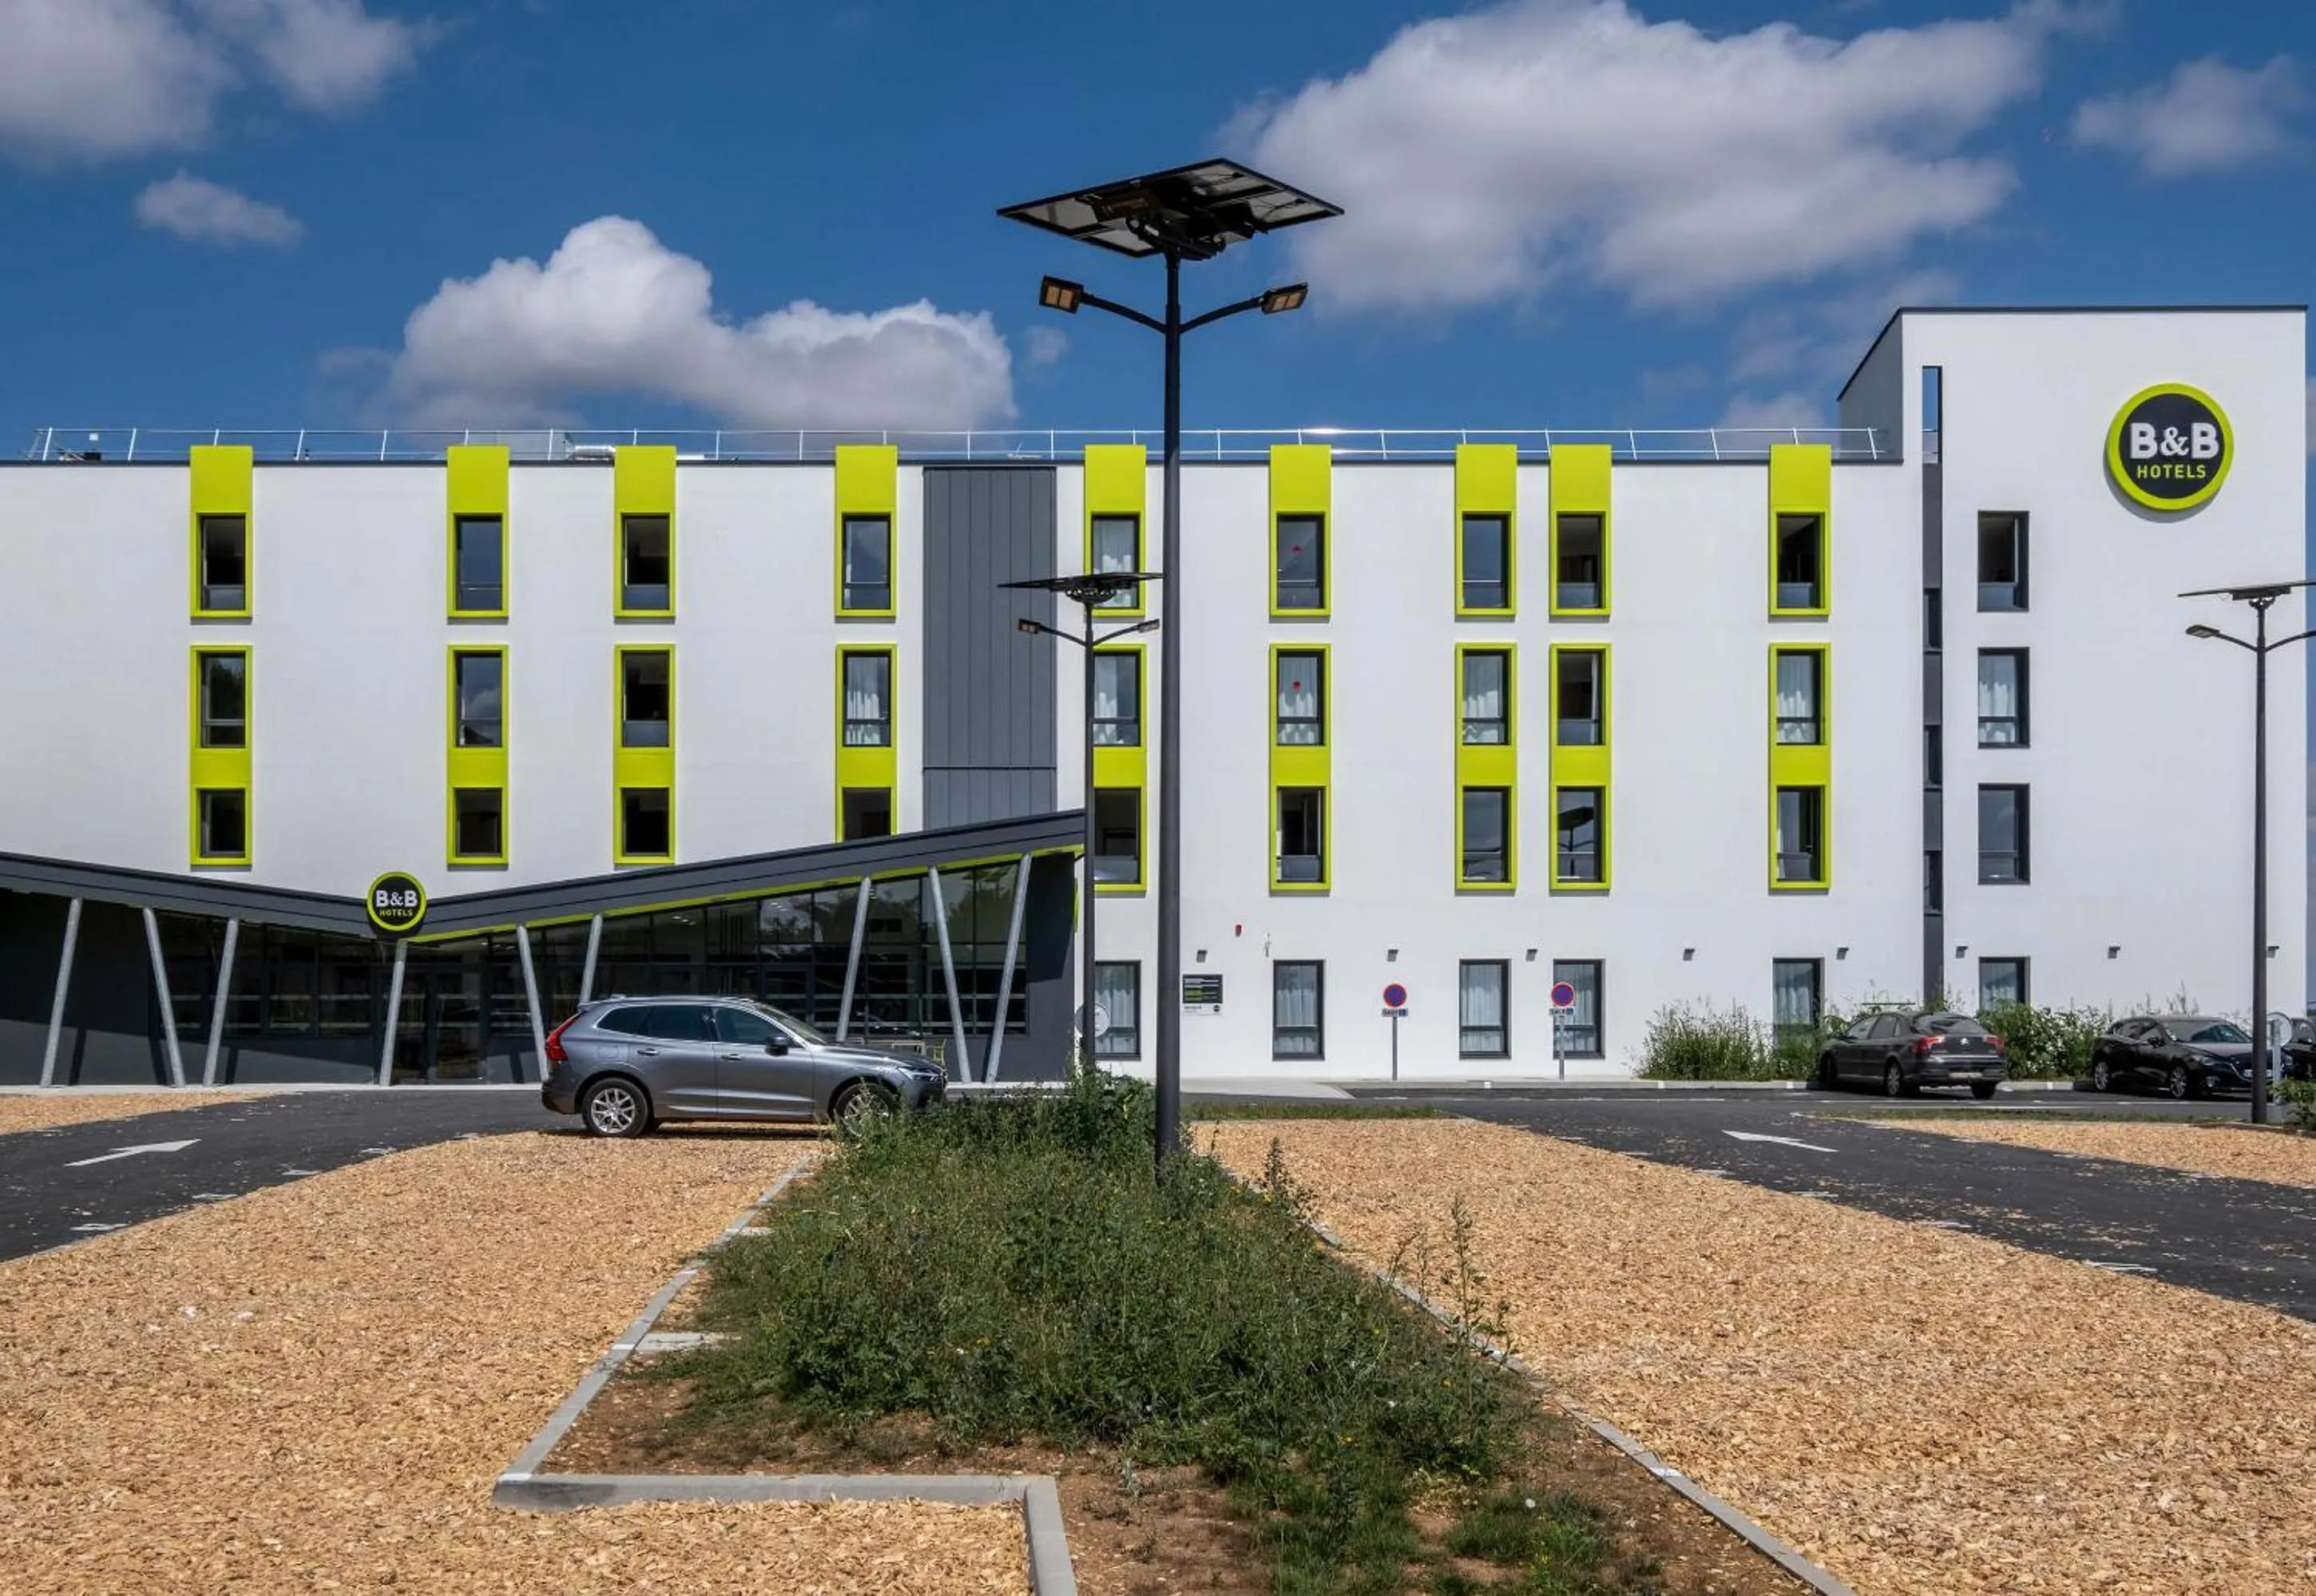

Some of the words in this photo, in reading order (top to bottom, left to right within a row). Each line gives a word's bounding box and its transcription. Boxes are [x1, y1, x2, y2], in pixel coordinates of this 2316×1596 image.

[2130, 422, 2219, 459] B&B
[2136, 465, 2207, 479] HOTELS
[375, 890, 418, 907] B&B
